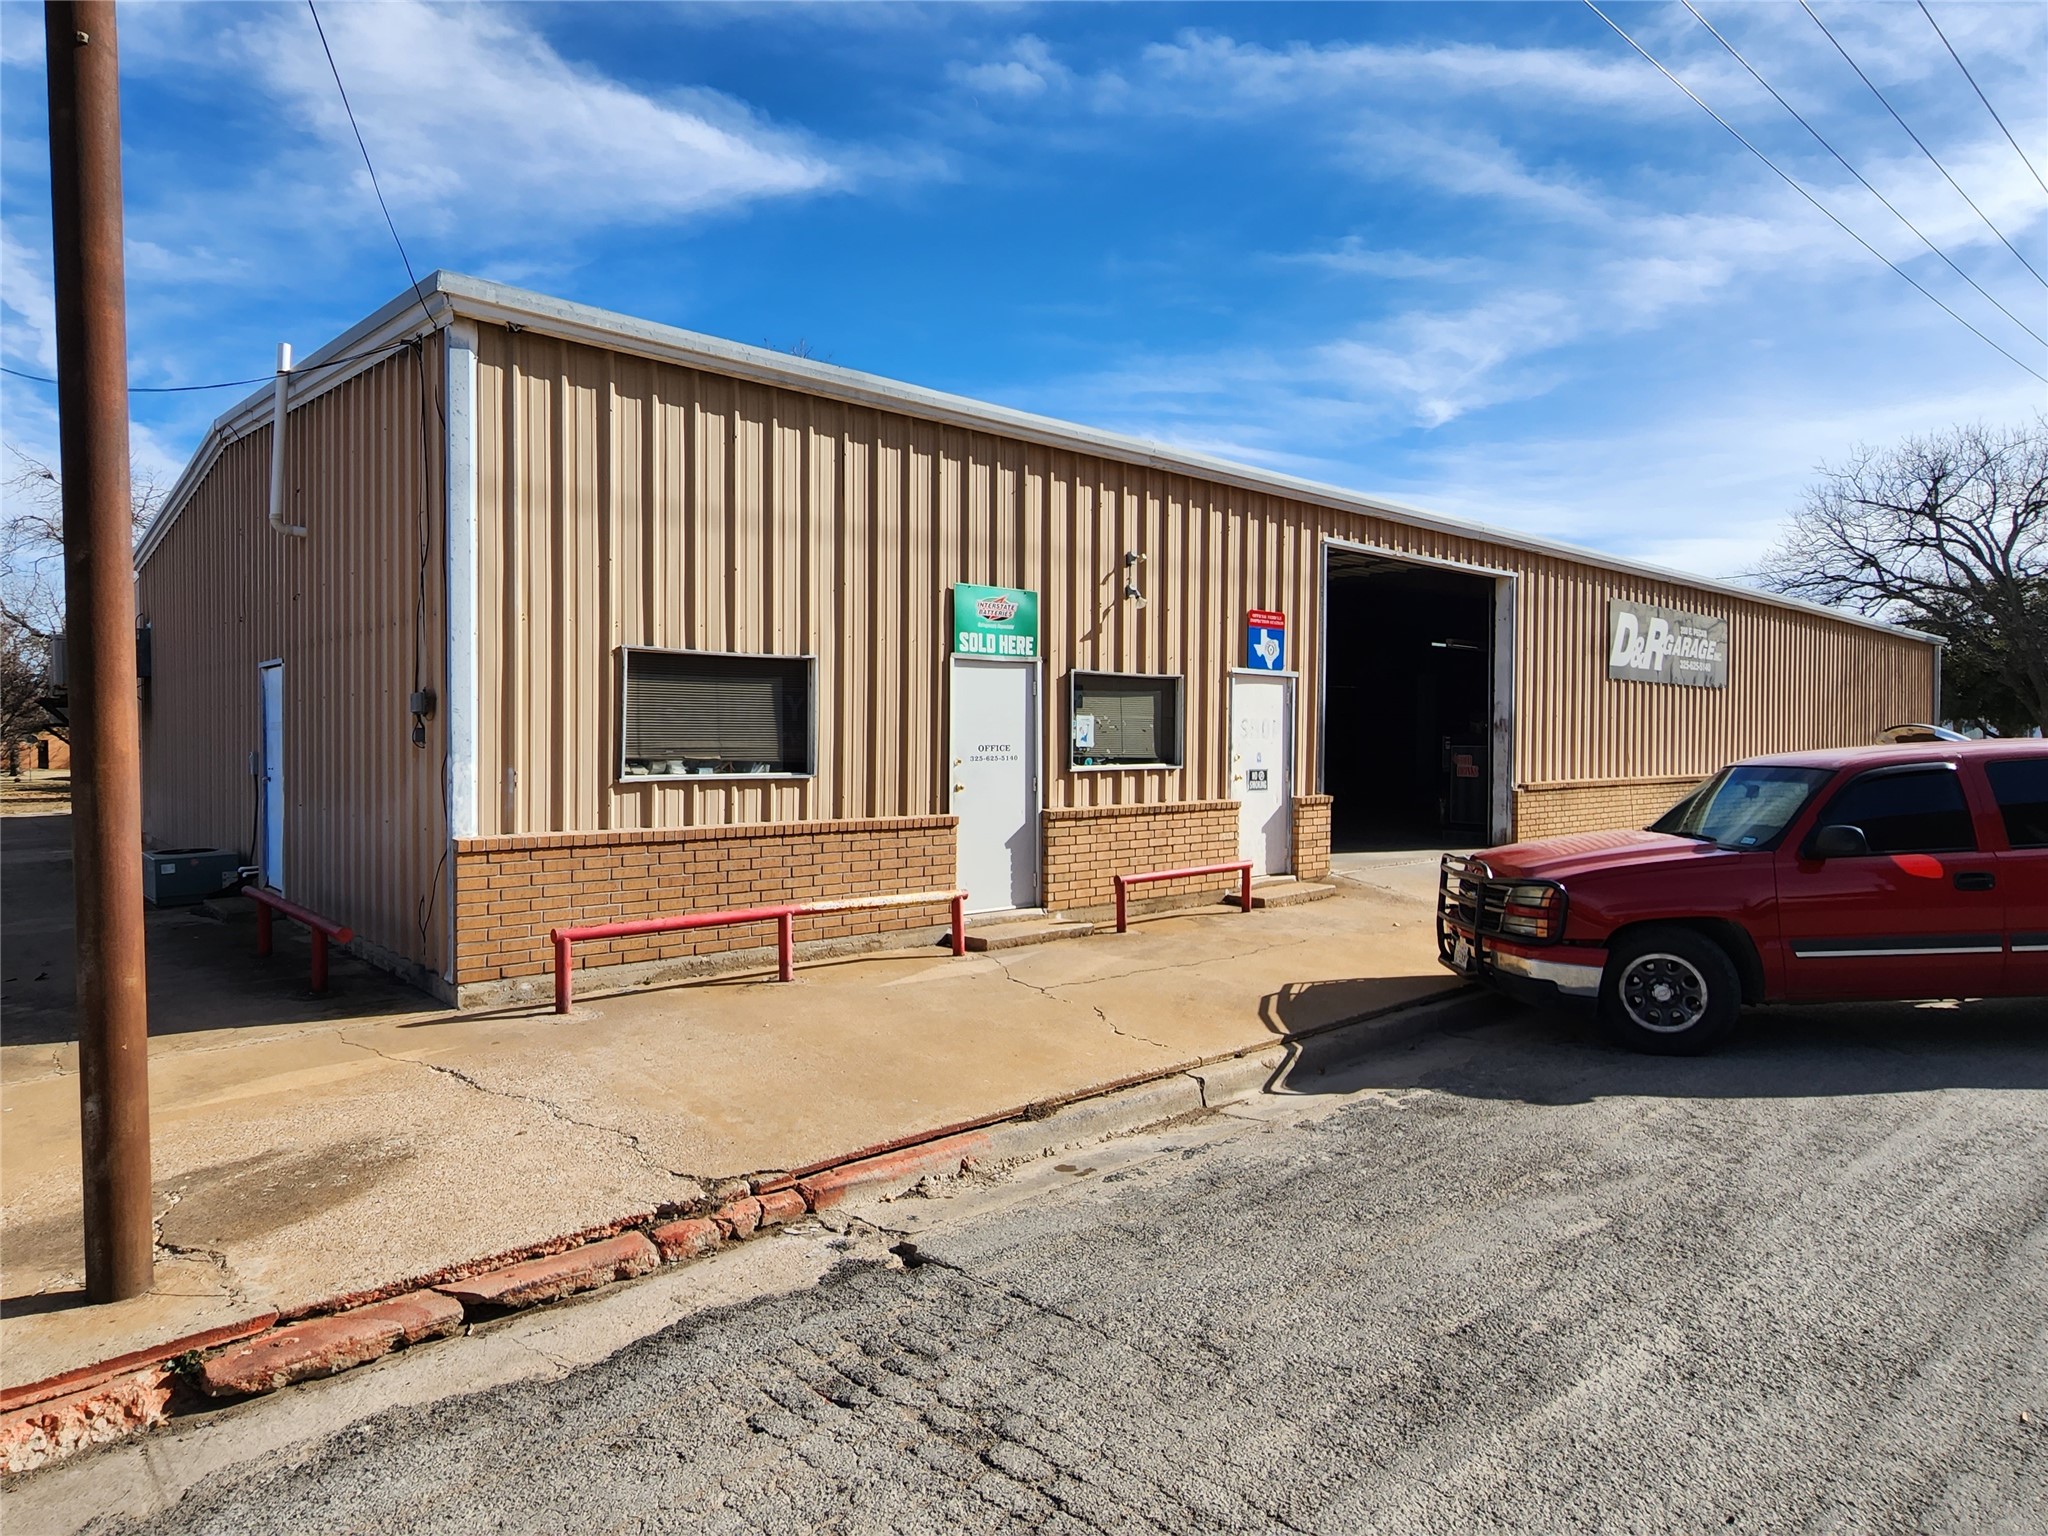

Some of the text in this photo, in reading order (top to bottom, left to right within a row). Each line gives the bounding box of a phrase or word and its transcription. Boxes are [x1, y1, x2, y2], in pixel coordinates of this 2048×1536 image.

[977, 602, 1015, 611] INTERSTATE
[978, 609, 1013, 618] BATTERIES
[959, 631, 1034, 656] SOLD HERE
[1609, 611, 1669, 671] D&R
[1662, 634, 1717, 661] GARAGE
[977, 744, 1011, 752] OFFICE
